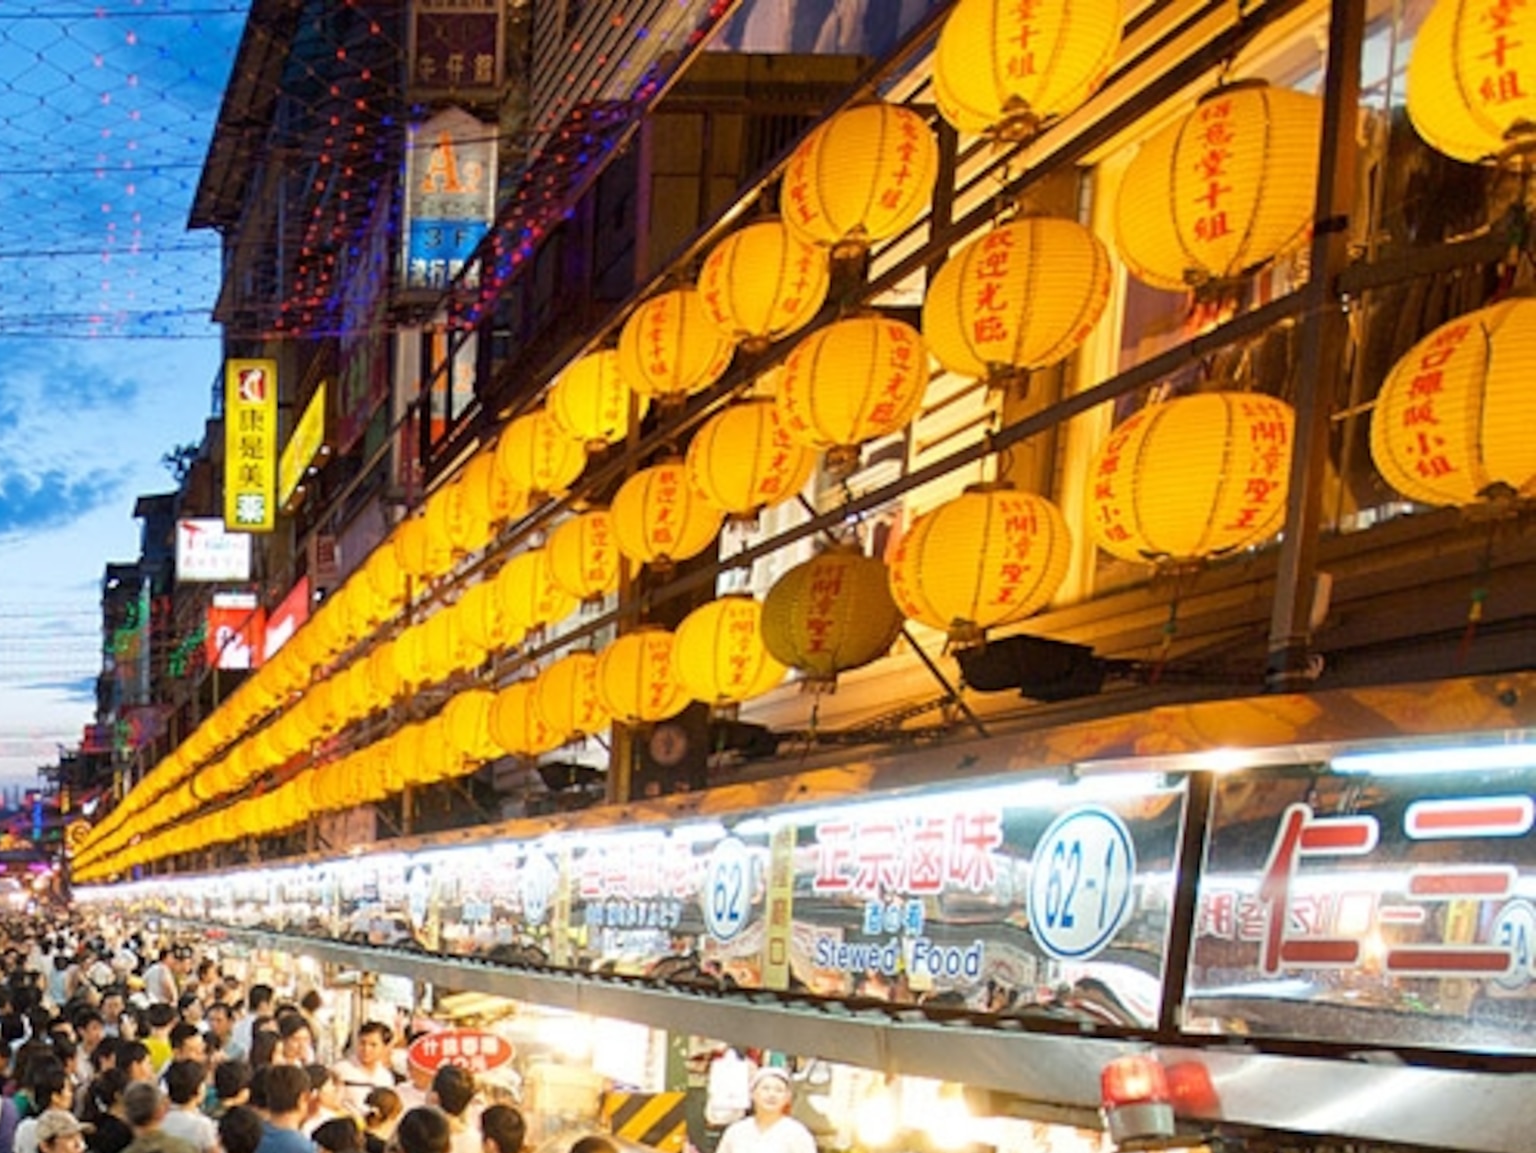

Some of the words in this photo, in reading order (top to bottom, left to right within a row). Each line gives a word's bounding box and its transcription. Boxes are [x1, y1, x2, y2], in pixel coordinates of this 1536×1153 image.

[975, 229, 1016, 345] 歡迎光臨
[238, 408, 265, 489] 康是美
[713, 860, 742, 923] 62
[815, 812, 999, 894] 正宗滷味
[1044, 838, 1116, 929] 62-1
[816, 938, 899, 974] Stewed
[911, 940, 984, 977] Food
